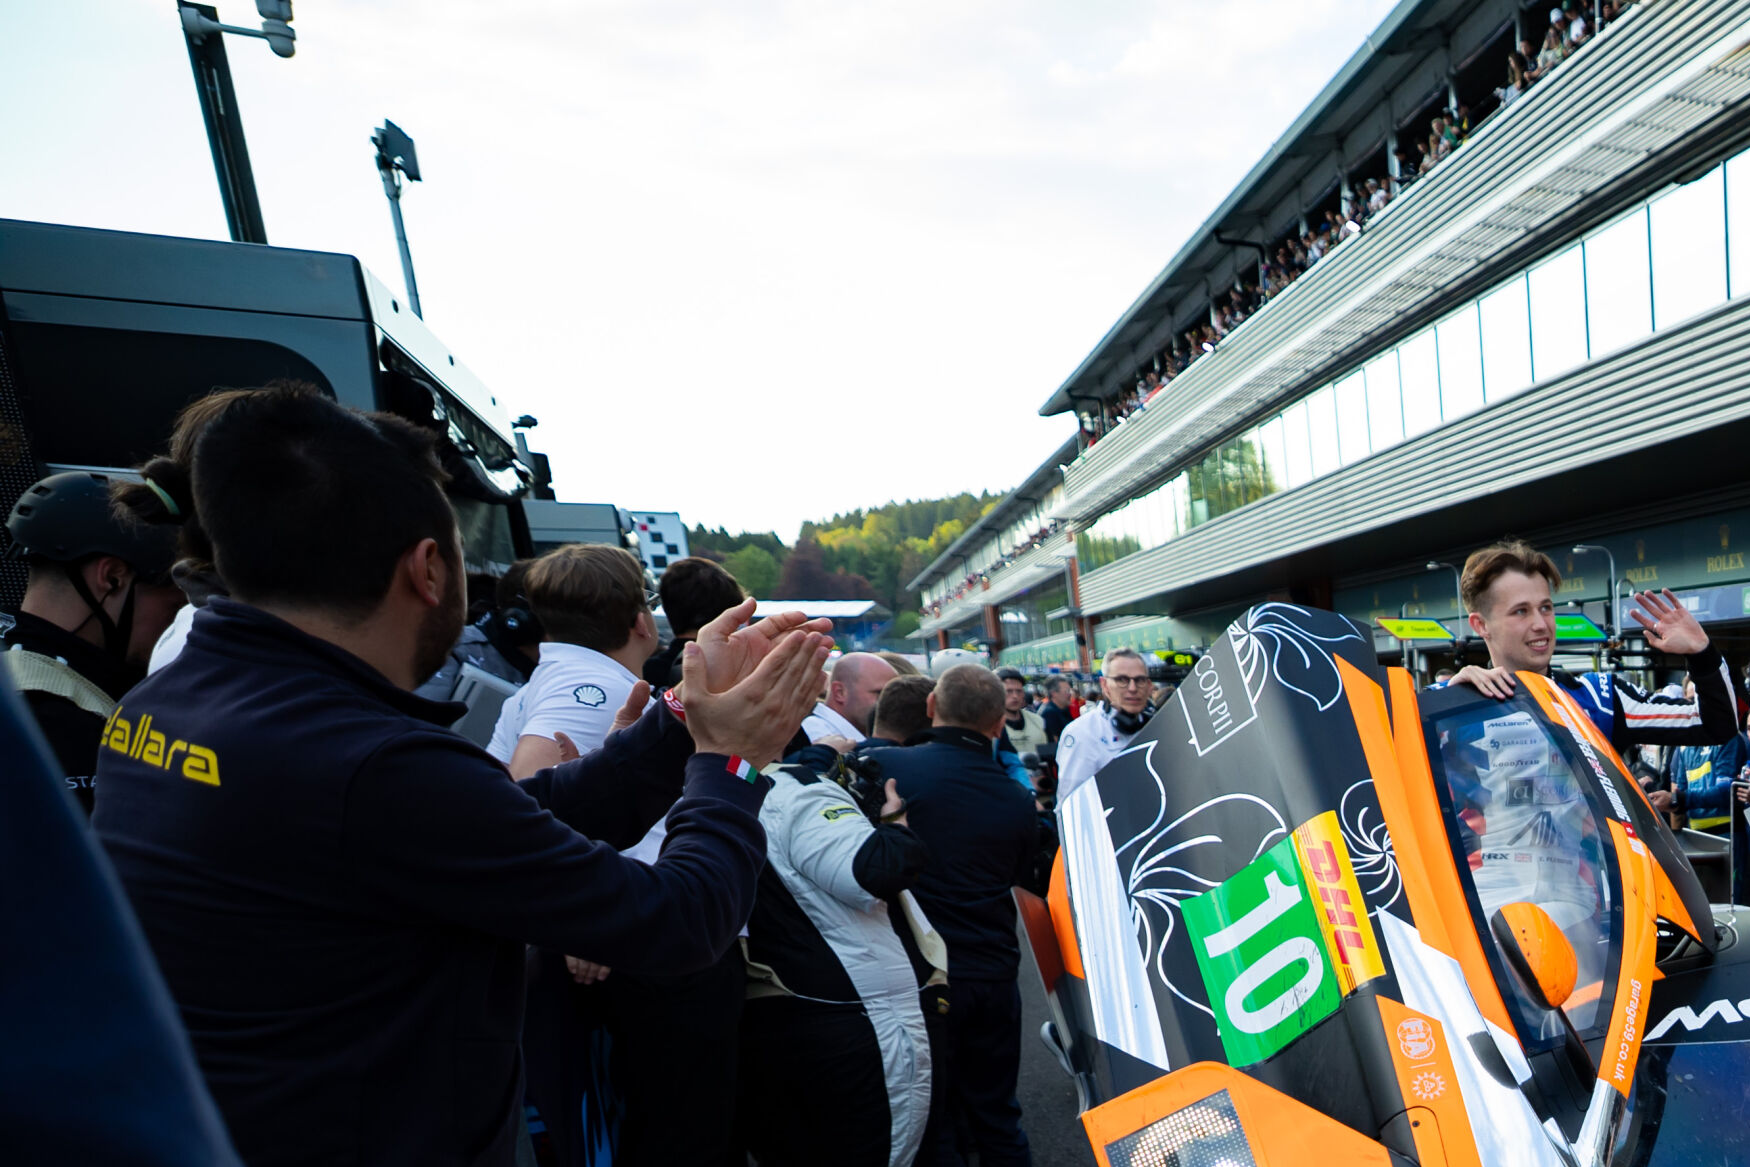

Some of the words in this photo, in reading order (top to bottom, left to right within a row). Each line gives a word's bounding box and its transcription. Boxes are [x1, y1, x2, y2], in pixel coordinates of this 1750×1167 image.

[1706, 552, 1744, 572] ROLEX
[1194, 649, 1233, 735] CORPII
[1487, 718, 1532, 728] McLaren
[1307, 840, 1365, 966] DHL
[1203, 870, 1324, 1034] 10
[1613, 979, 1642, 1082] garage59.co.uk
